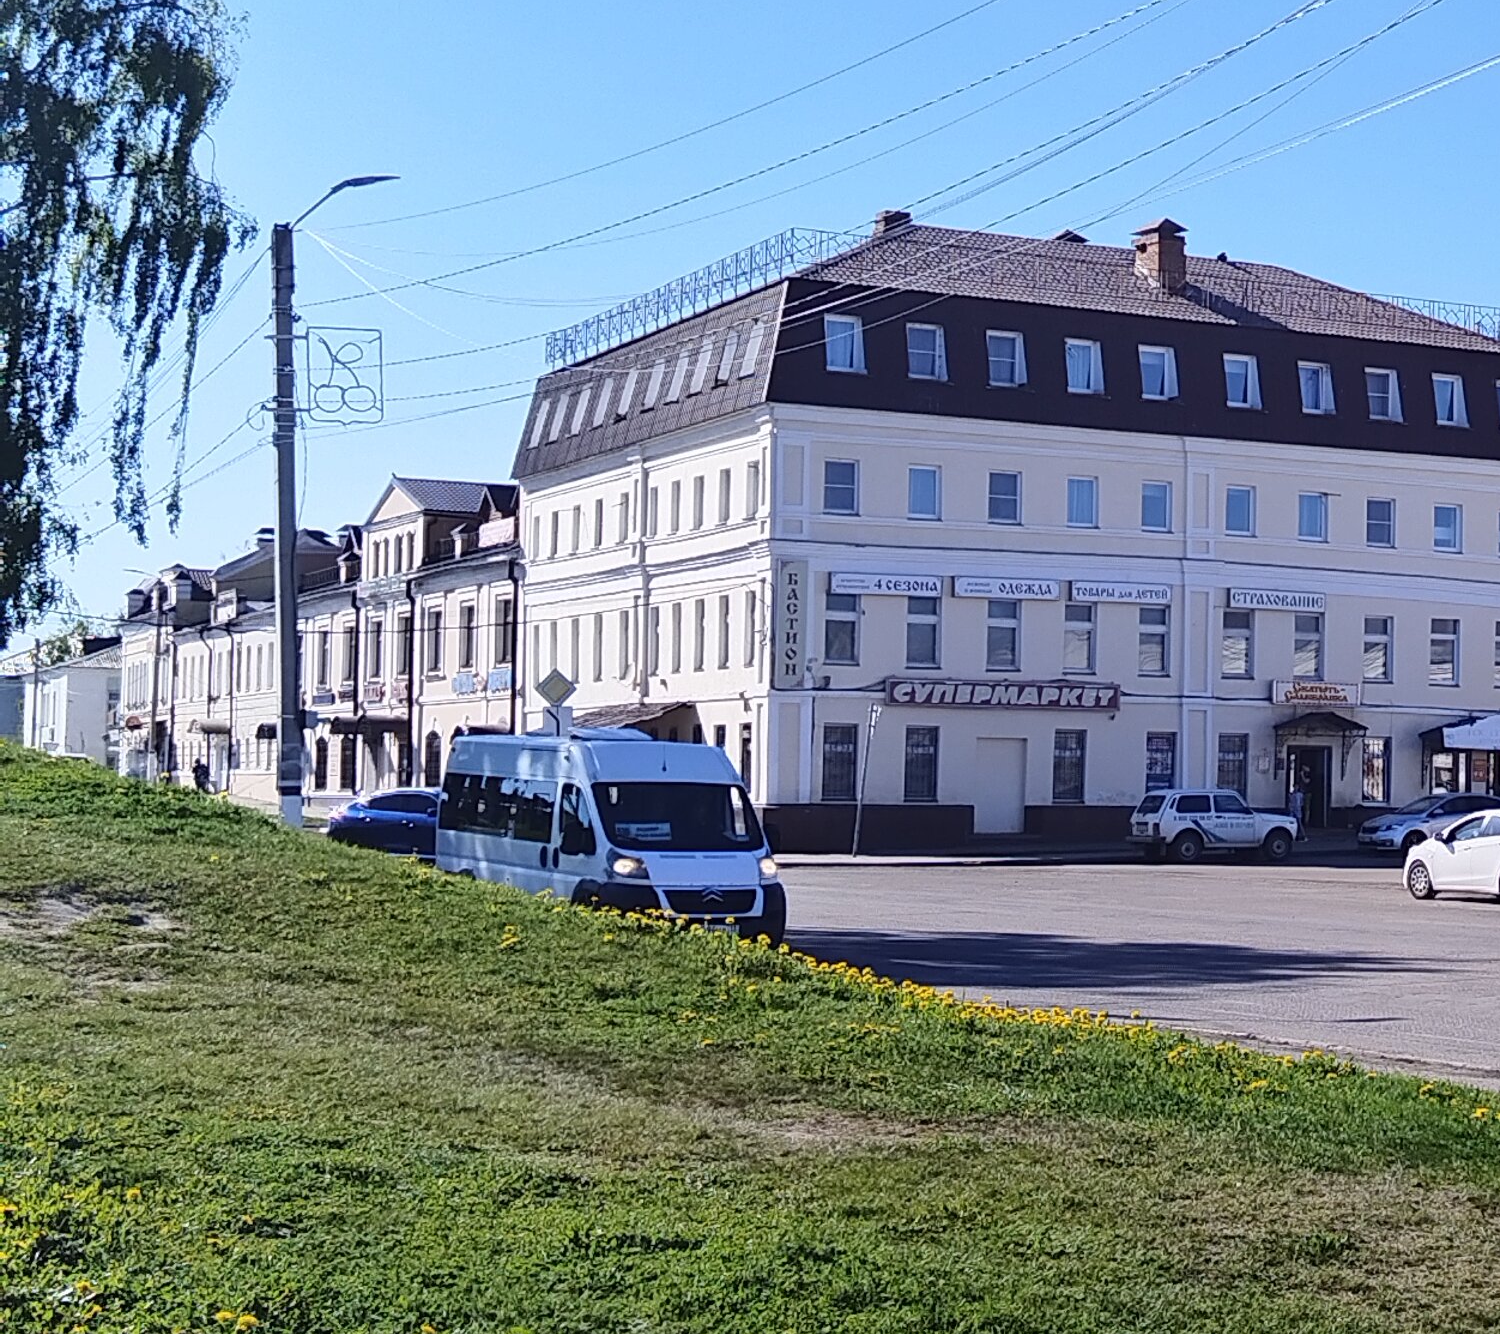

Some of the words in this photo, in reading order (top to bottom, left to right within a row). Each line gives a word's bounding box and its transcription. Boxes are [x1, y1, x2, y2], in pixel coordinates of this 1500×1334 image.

[873, 578, 882, 590] 4
[886, 579, 938, 592] СЕЗОНА
[998, 582, 1052, 596] ОДЕЖДА
[1075, 587, 1115, 598] ТОВАРЫ
[1135, 588, 1168, 600] ДЕТЕЙ
[1232, 591, 1324, 609] СТРАХОВАНИЕ
[784, 572, 799, 676] БАСТИОН
[892, 683, 1115, 707] СУПЕРМАРКЕТ
